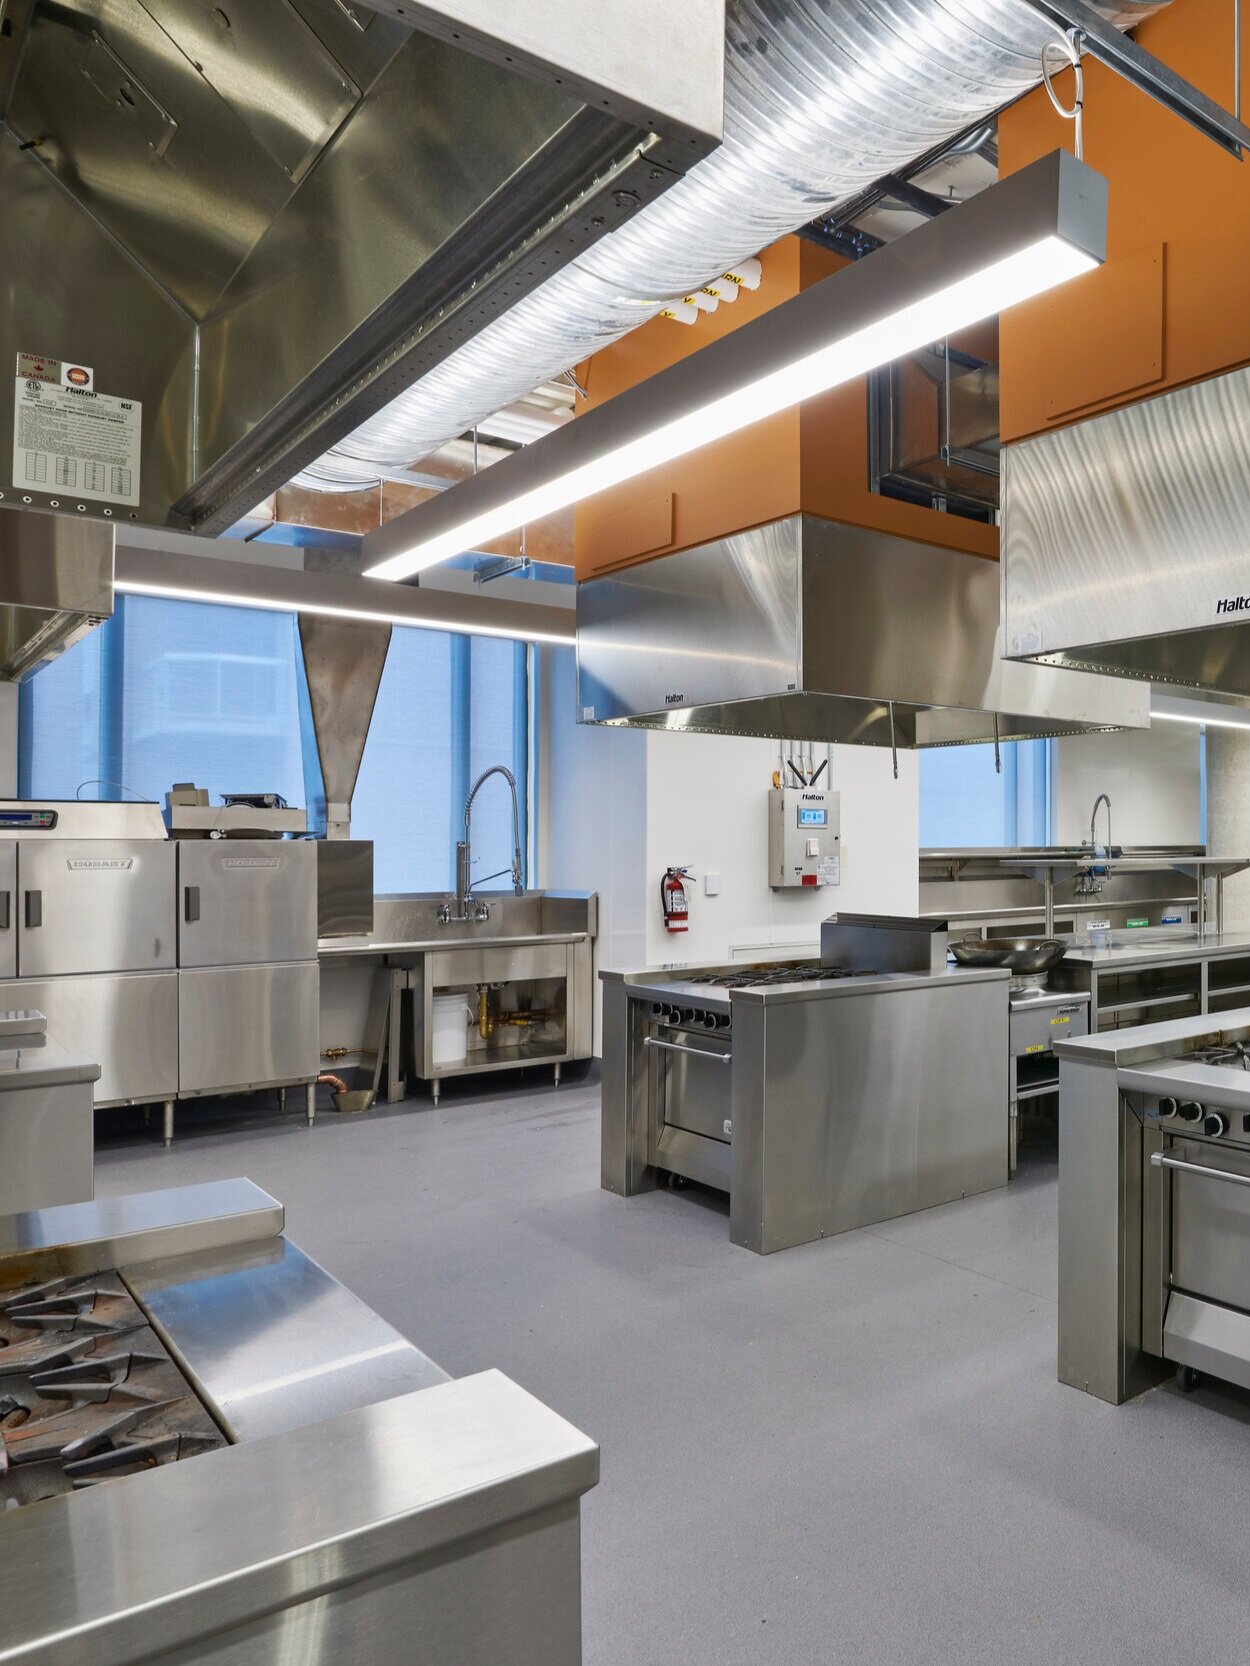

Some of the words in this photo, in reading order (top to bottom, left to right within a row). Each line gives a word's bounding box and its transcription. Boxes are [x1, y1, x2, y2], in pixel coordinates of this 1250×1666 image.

[21, 353, 46, 364] MADE
[48, 359, 57, 367] IN
[21, 371, 57, 383] CANADA
[65, 386, 97, 398] Halton
[665, 694, 684, 704] Halton
[801, 793, 825, 801] Halton
